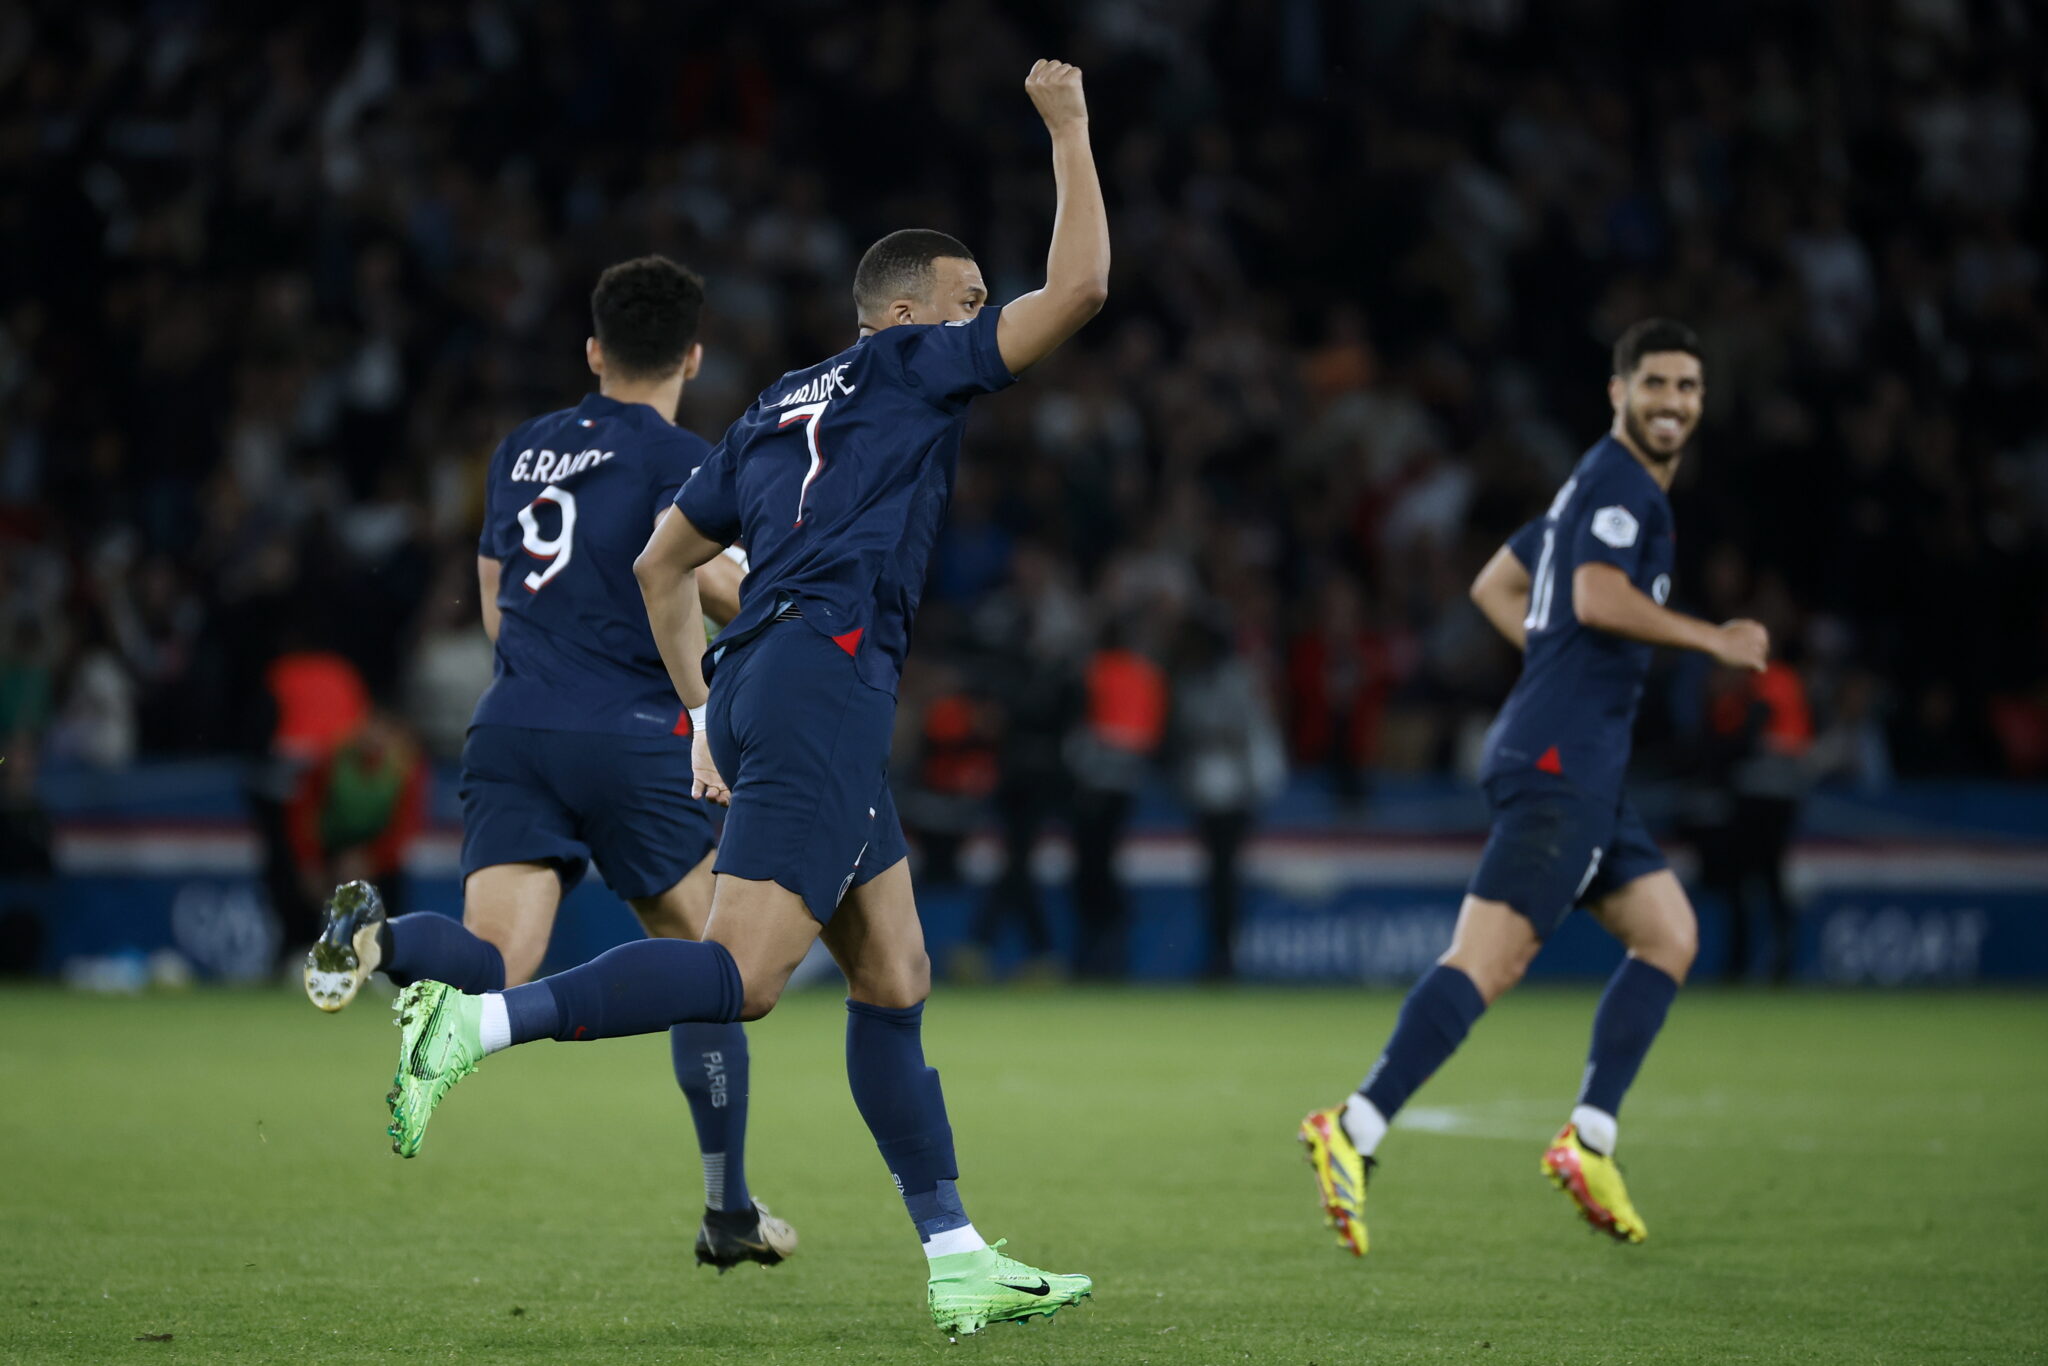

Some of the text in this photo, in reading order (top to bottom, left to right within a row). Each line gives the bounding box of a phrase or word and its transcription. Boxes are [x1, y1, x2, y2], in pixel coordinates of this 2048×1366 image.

[778, 400, 831, 527] 7
[517, 485, 577, 595] 9
[702, 1051, 728, 1108] PARIS
